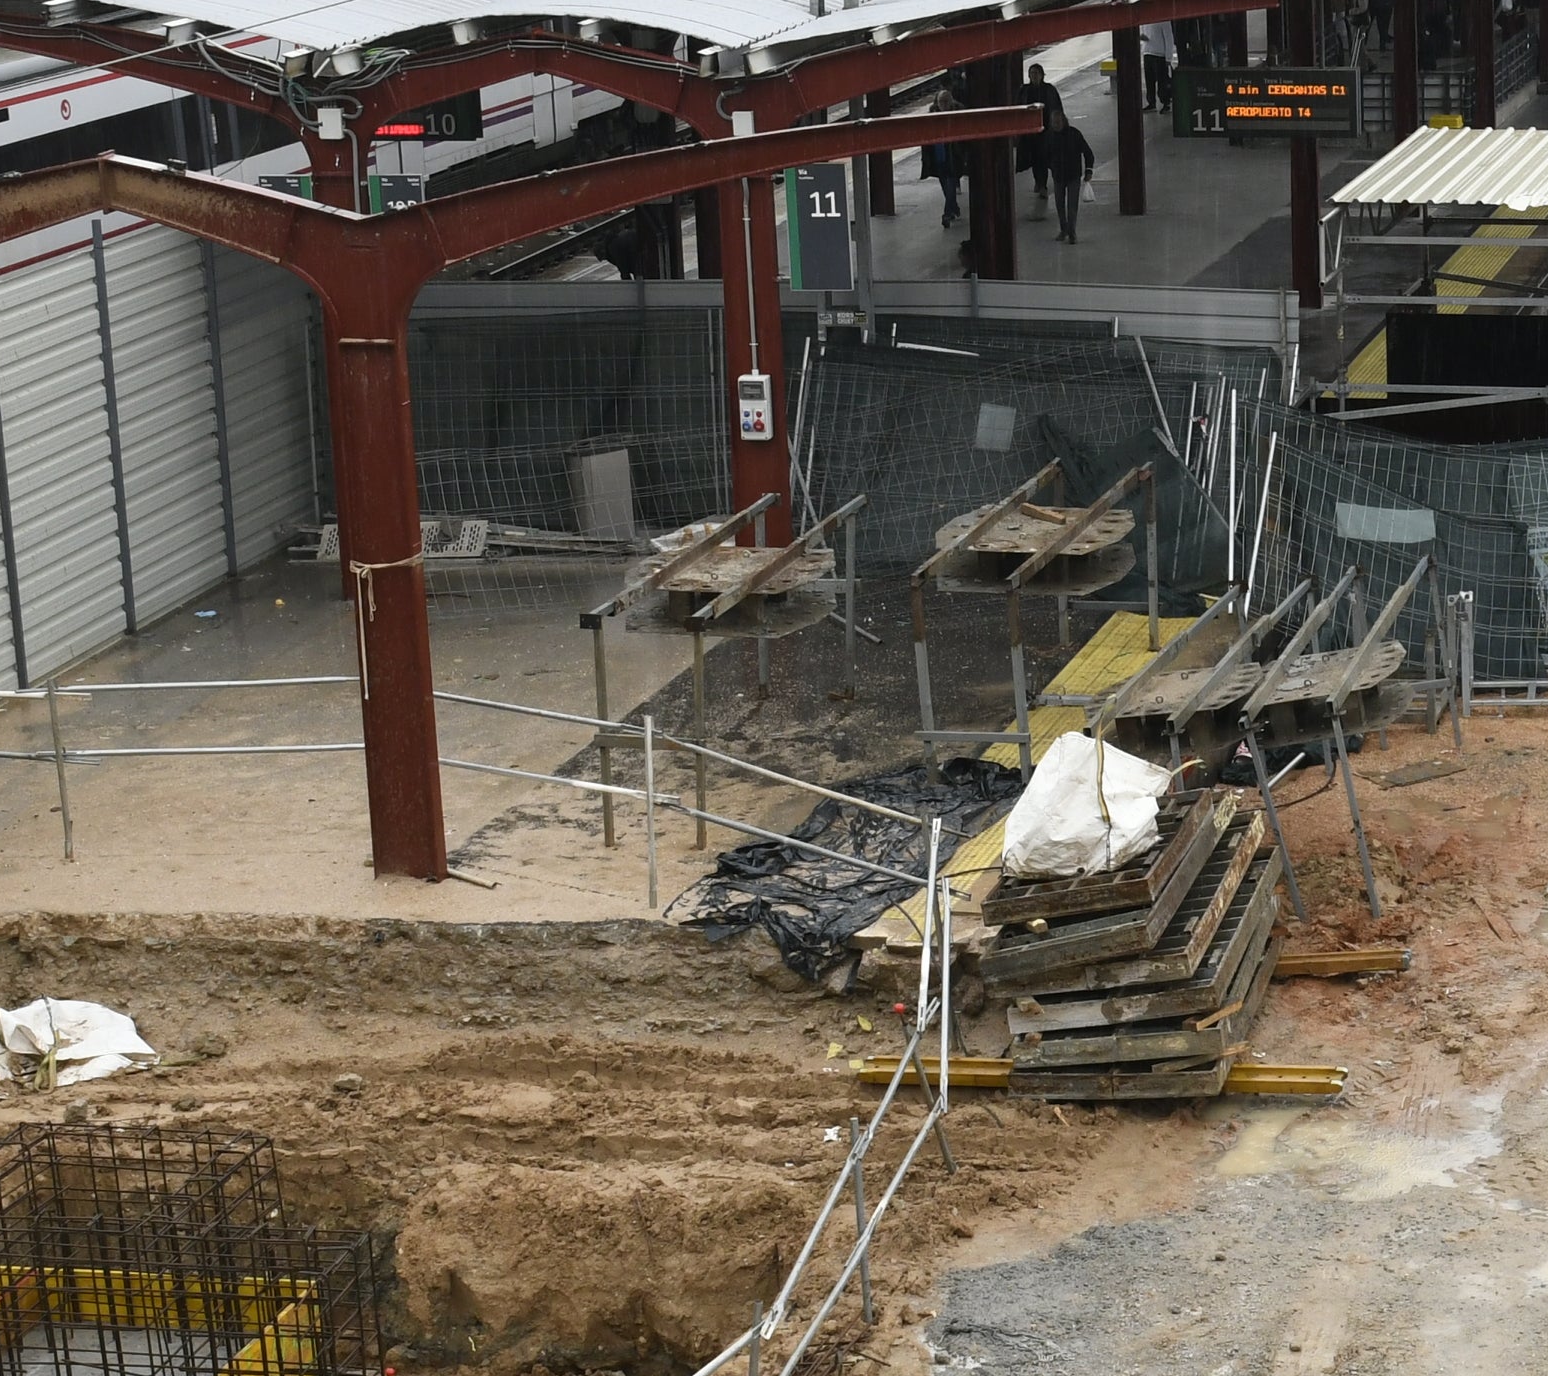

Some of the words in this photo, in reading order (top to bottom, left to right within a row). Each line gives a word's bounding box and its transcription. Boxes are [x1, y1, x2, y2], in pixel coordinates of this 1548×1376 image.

[1226, 85, 1233, 95] 4
[1267, 85, 1327, 95] CERCANIAS
[1332, 86, 1346, 96] C1
[1192, 108, 1225, 132] 11
[1226, 106, 1292, 118] AEROPUERTO
[1298, 107, 1312, 118] T4
[425, 113, 456, 136] 10
[809, 191, 841, 218] 11
